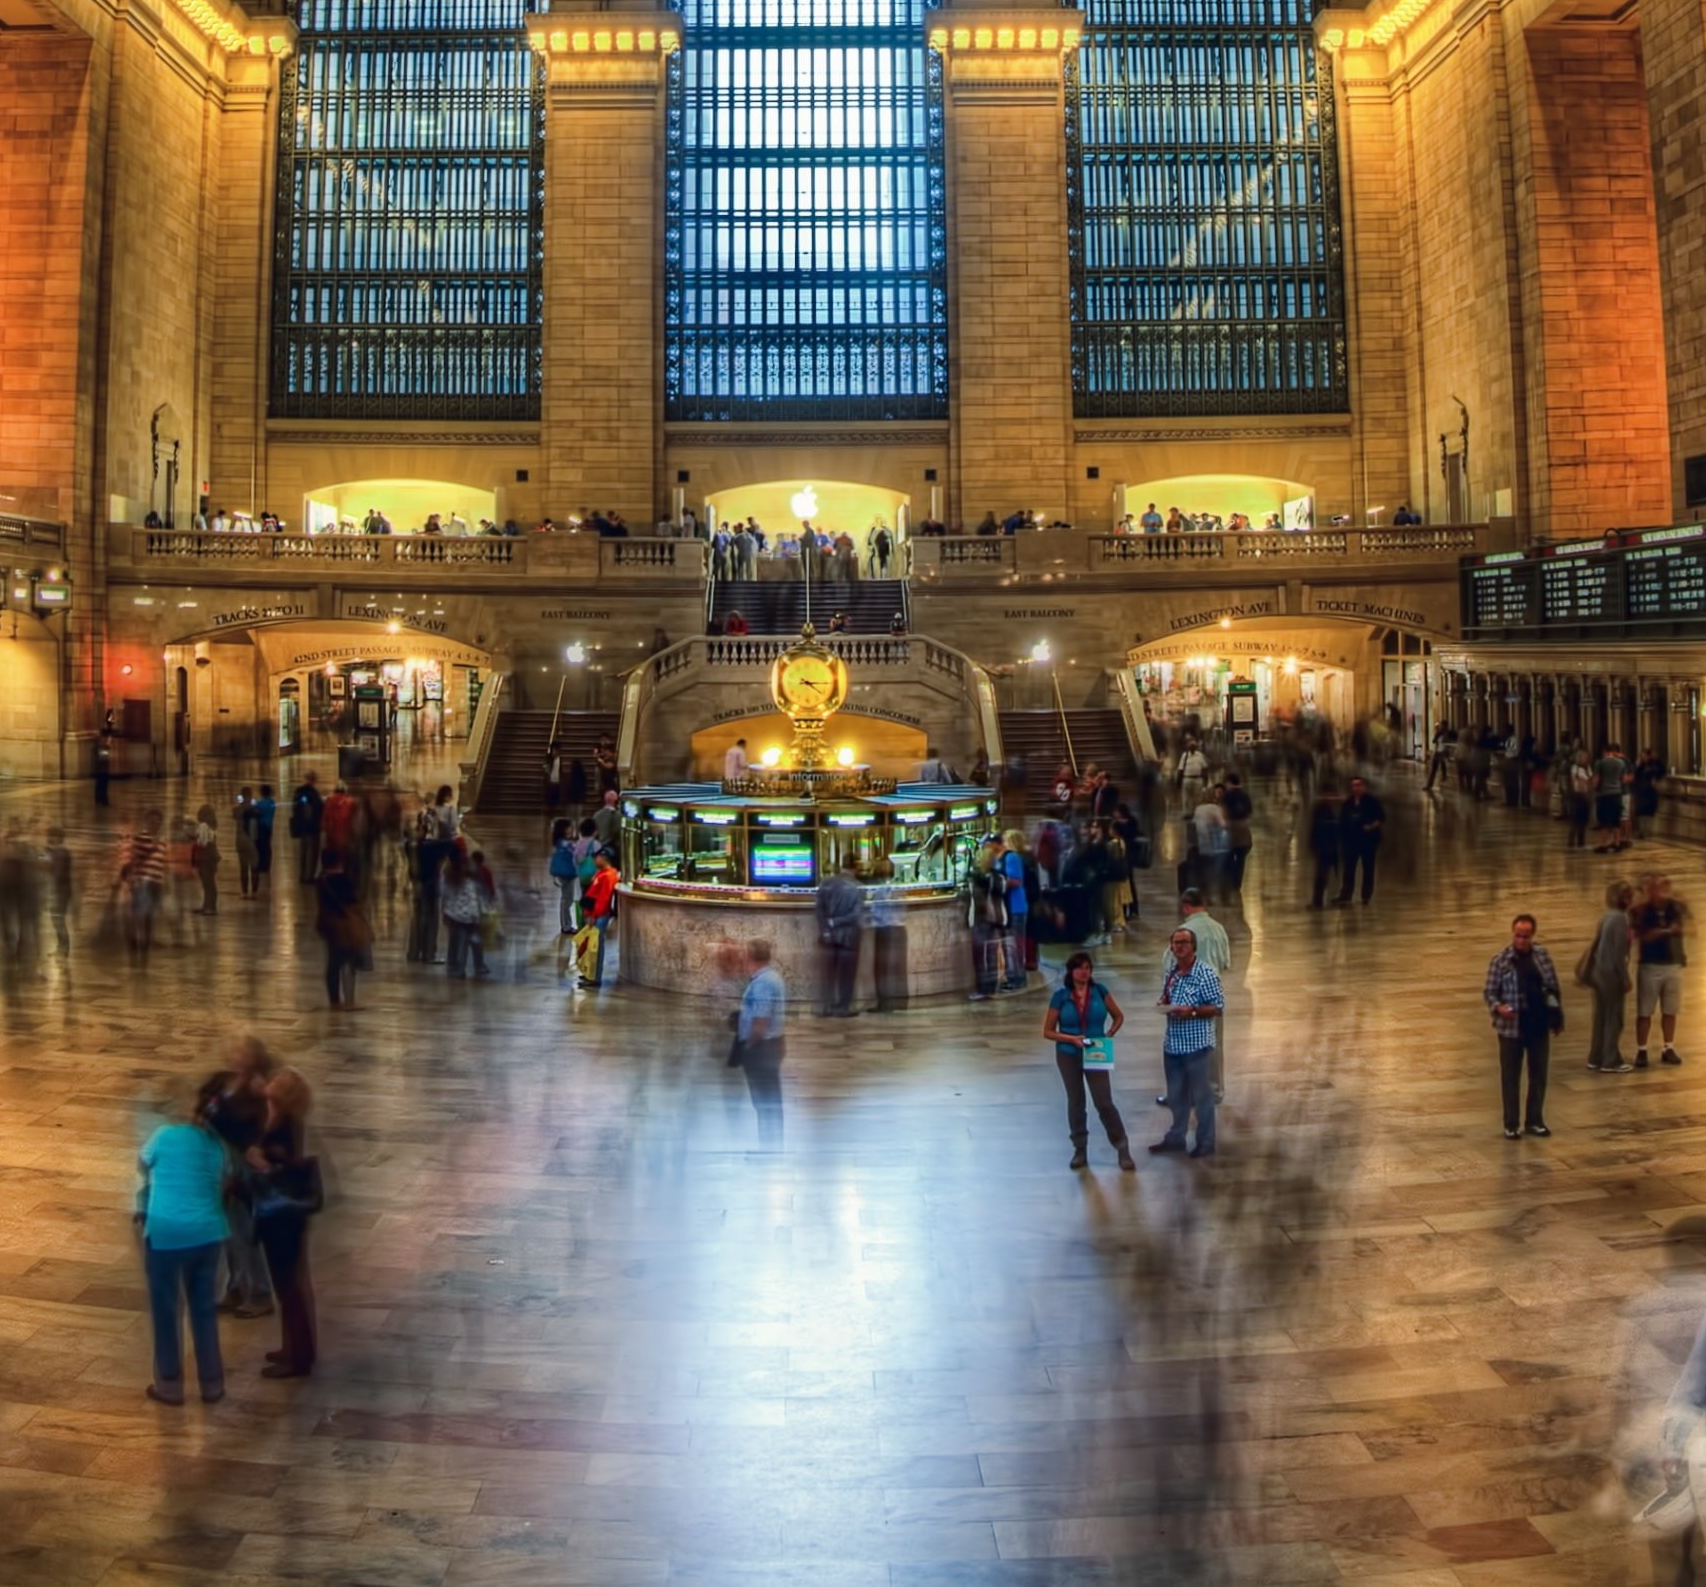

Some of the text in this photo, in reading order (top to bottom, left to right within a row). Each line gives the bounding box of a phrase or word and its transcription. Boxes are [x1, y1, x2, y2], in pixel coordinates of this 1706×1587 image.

[213, 609, 259, 626] TRACKS
[541, 610, 566, 620] EAST
[1004, 609, 1076, 619] EAST BALCONY
[1170, 601, 1272, 630] LEXINGTON AVE
[1316, 600, 1426, 625] TICKET MACHINES
[424, 619, 449, 633] AVE
[320, 647, 357, 660] STREET
[359, 645, 402, 657] PASSAGE
[1141, 645, 1180, 660] STREET
[1232, 642, 1278, 653] SUBWAY
